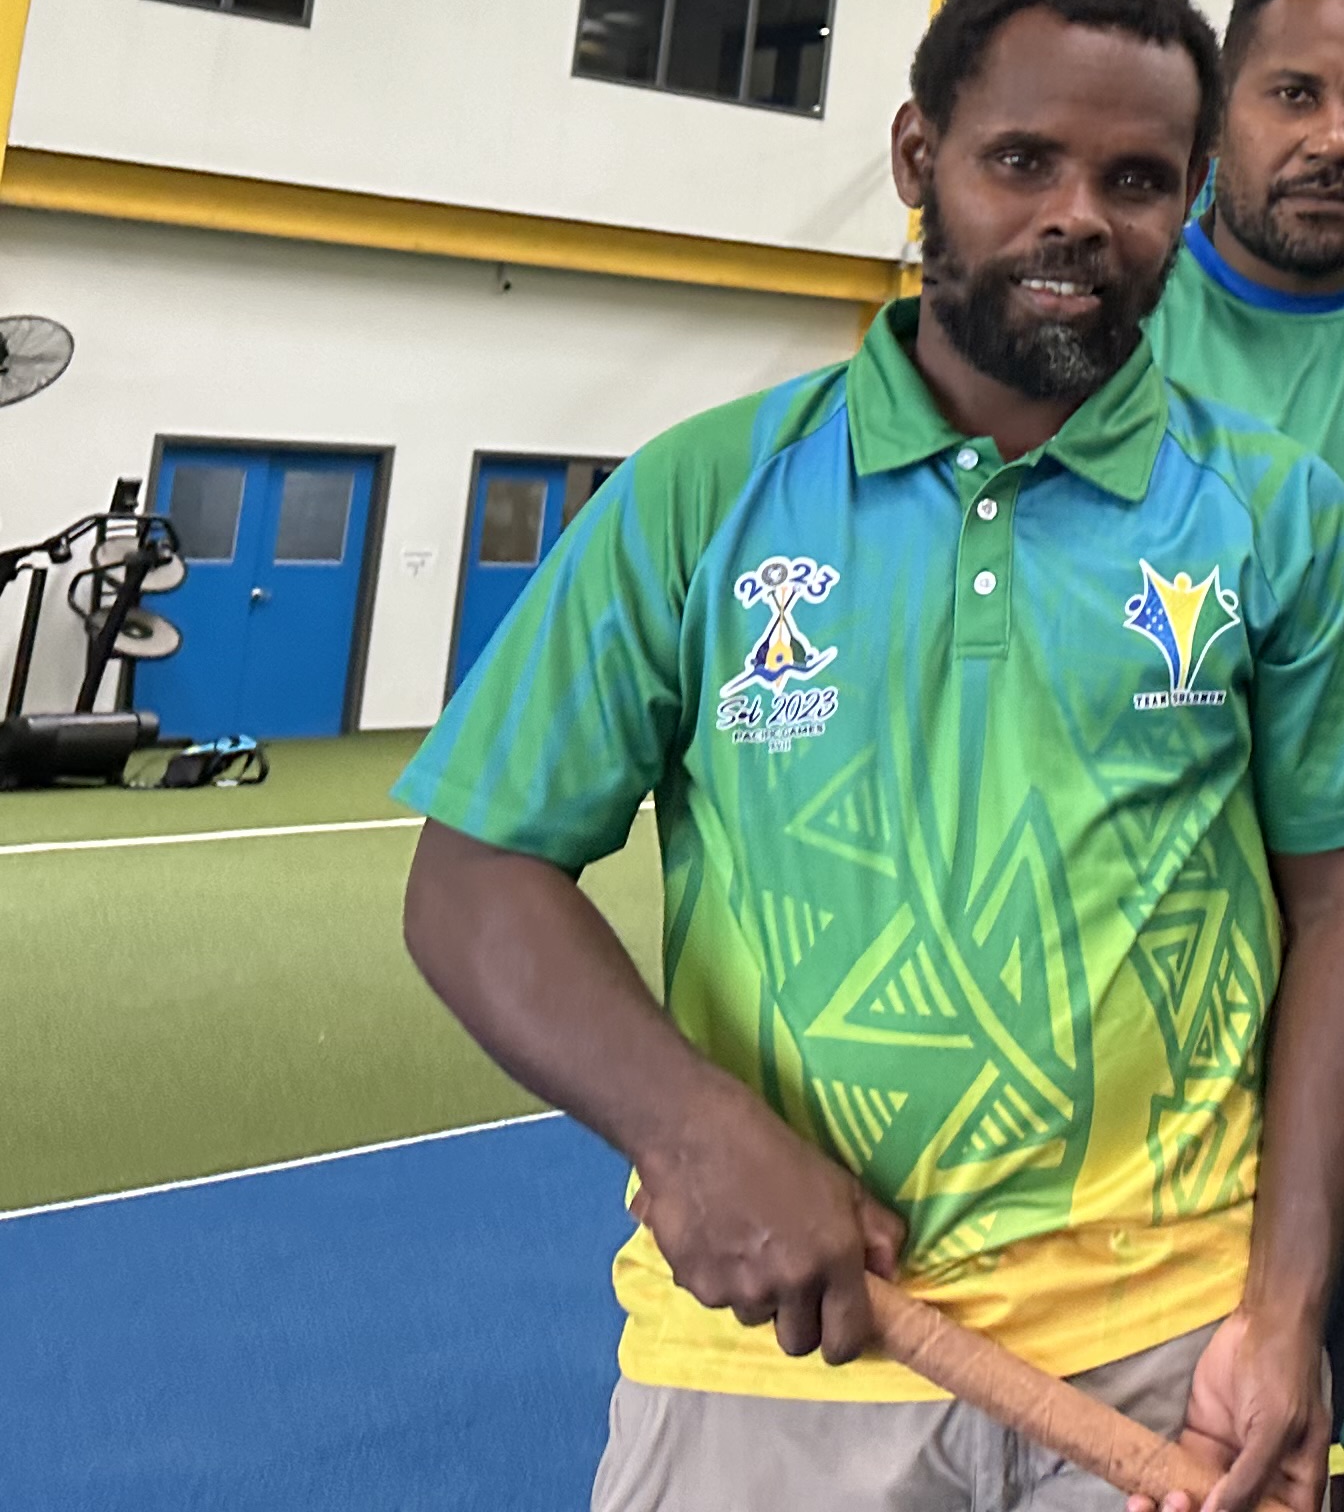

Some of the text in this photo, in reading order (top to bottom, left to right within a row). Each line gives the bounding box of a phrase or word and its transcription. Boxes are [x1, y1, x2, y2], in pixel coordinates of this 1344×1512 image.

[739, 562, 834, 601] 2023
[720, 690, 836, 727] Sol 2023
[1136, 691, 1224, 708] TEAM SOLOMON
